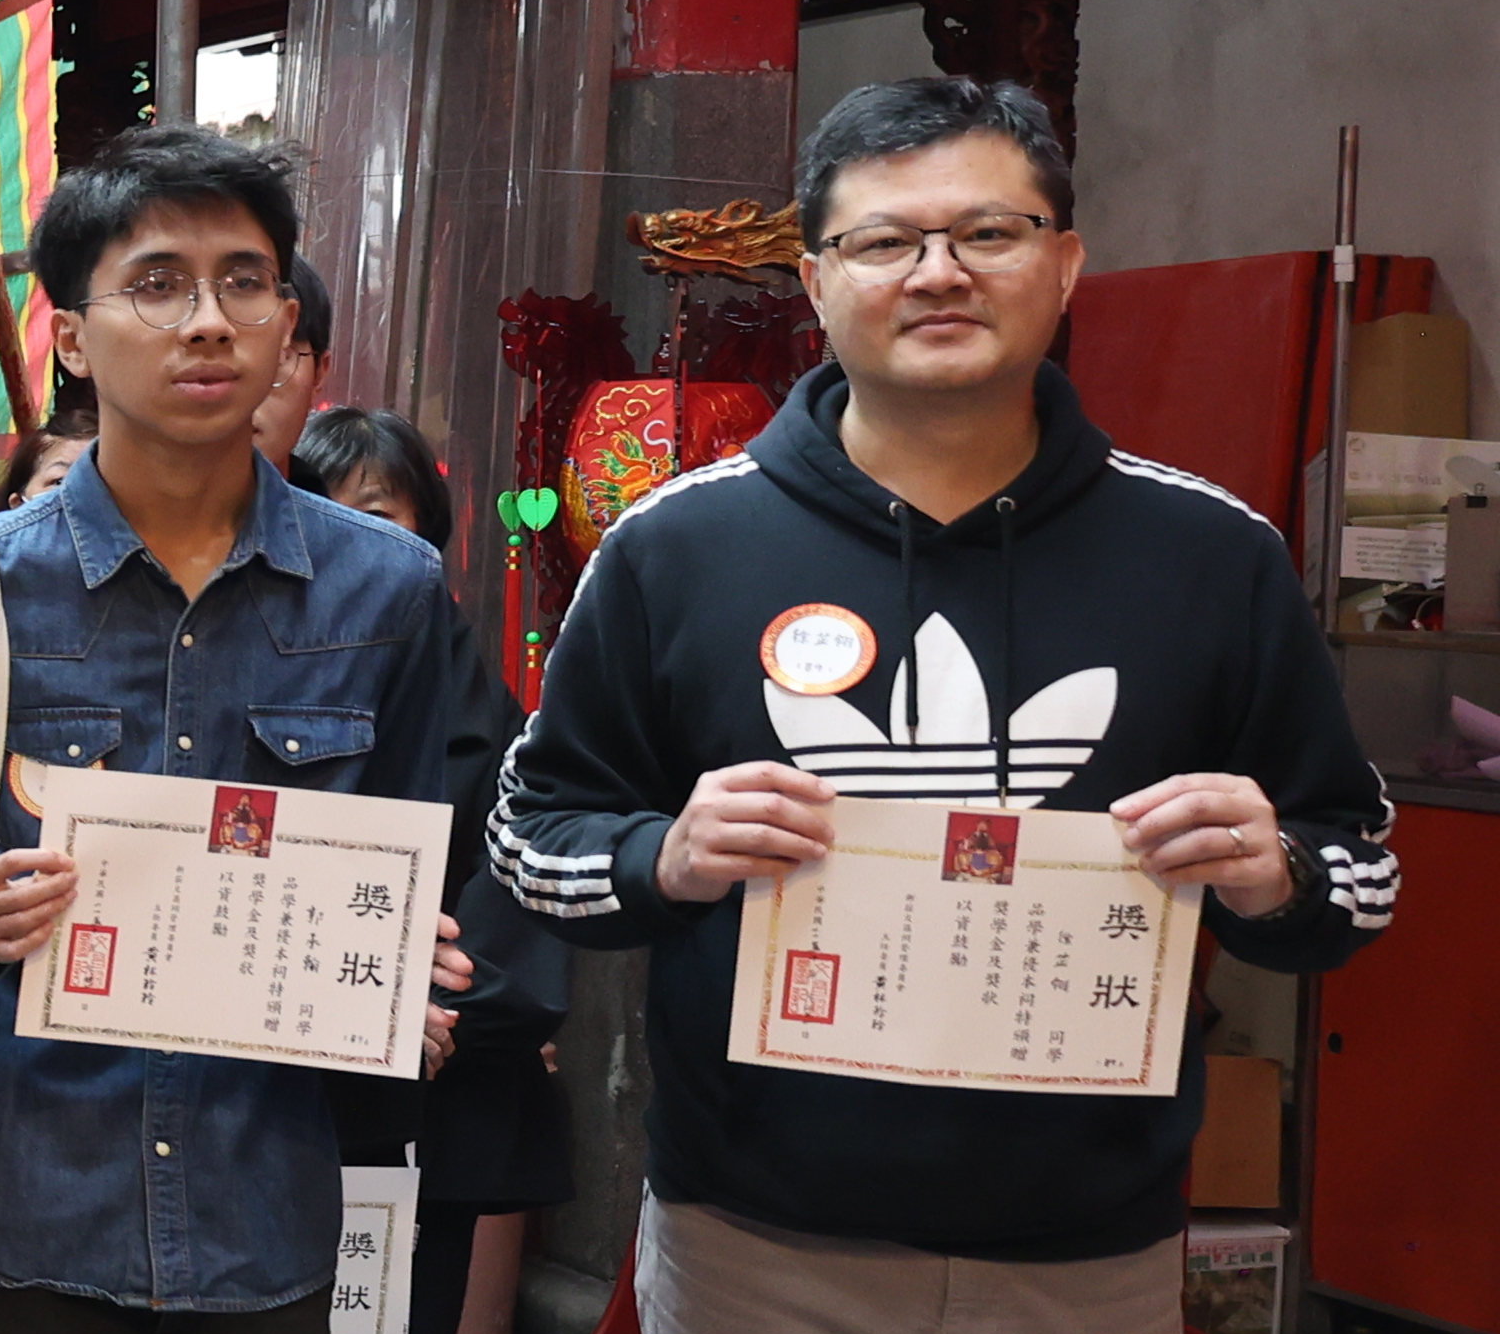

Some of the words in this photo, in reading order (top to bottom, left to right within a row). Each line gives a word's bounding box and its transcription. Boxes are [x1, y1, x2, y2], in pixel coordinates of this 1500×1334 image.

[336, 882, 394, 987] 獎狀
[1089, 903, 1150, 1009] 獎狀
[333, 1232, 377, 1311] 獎狀
